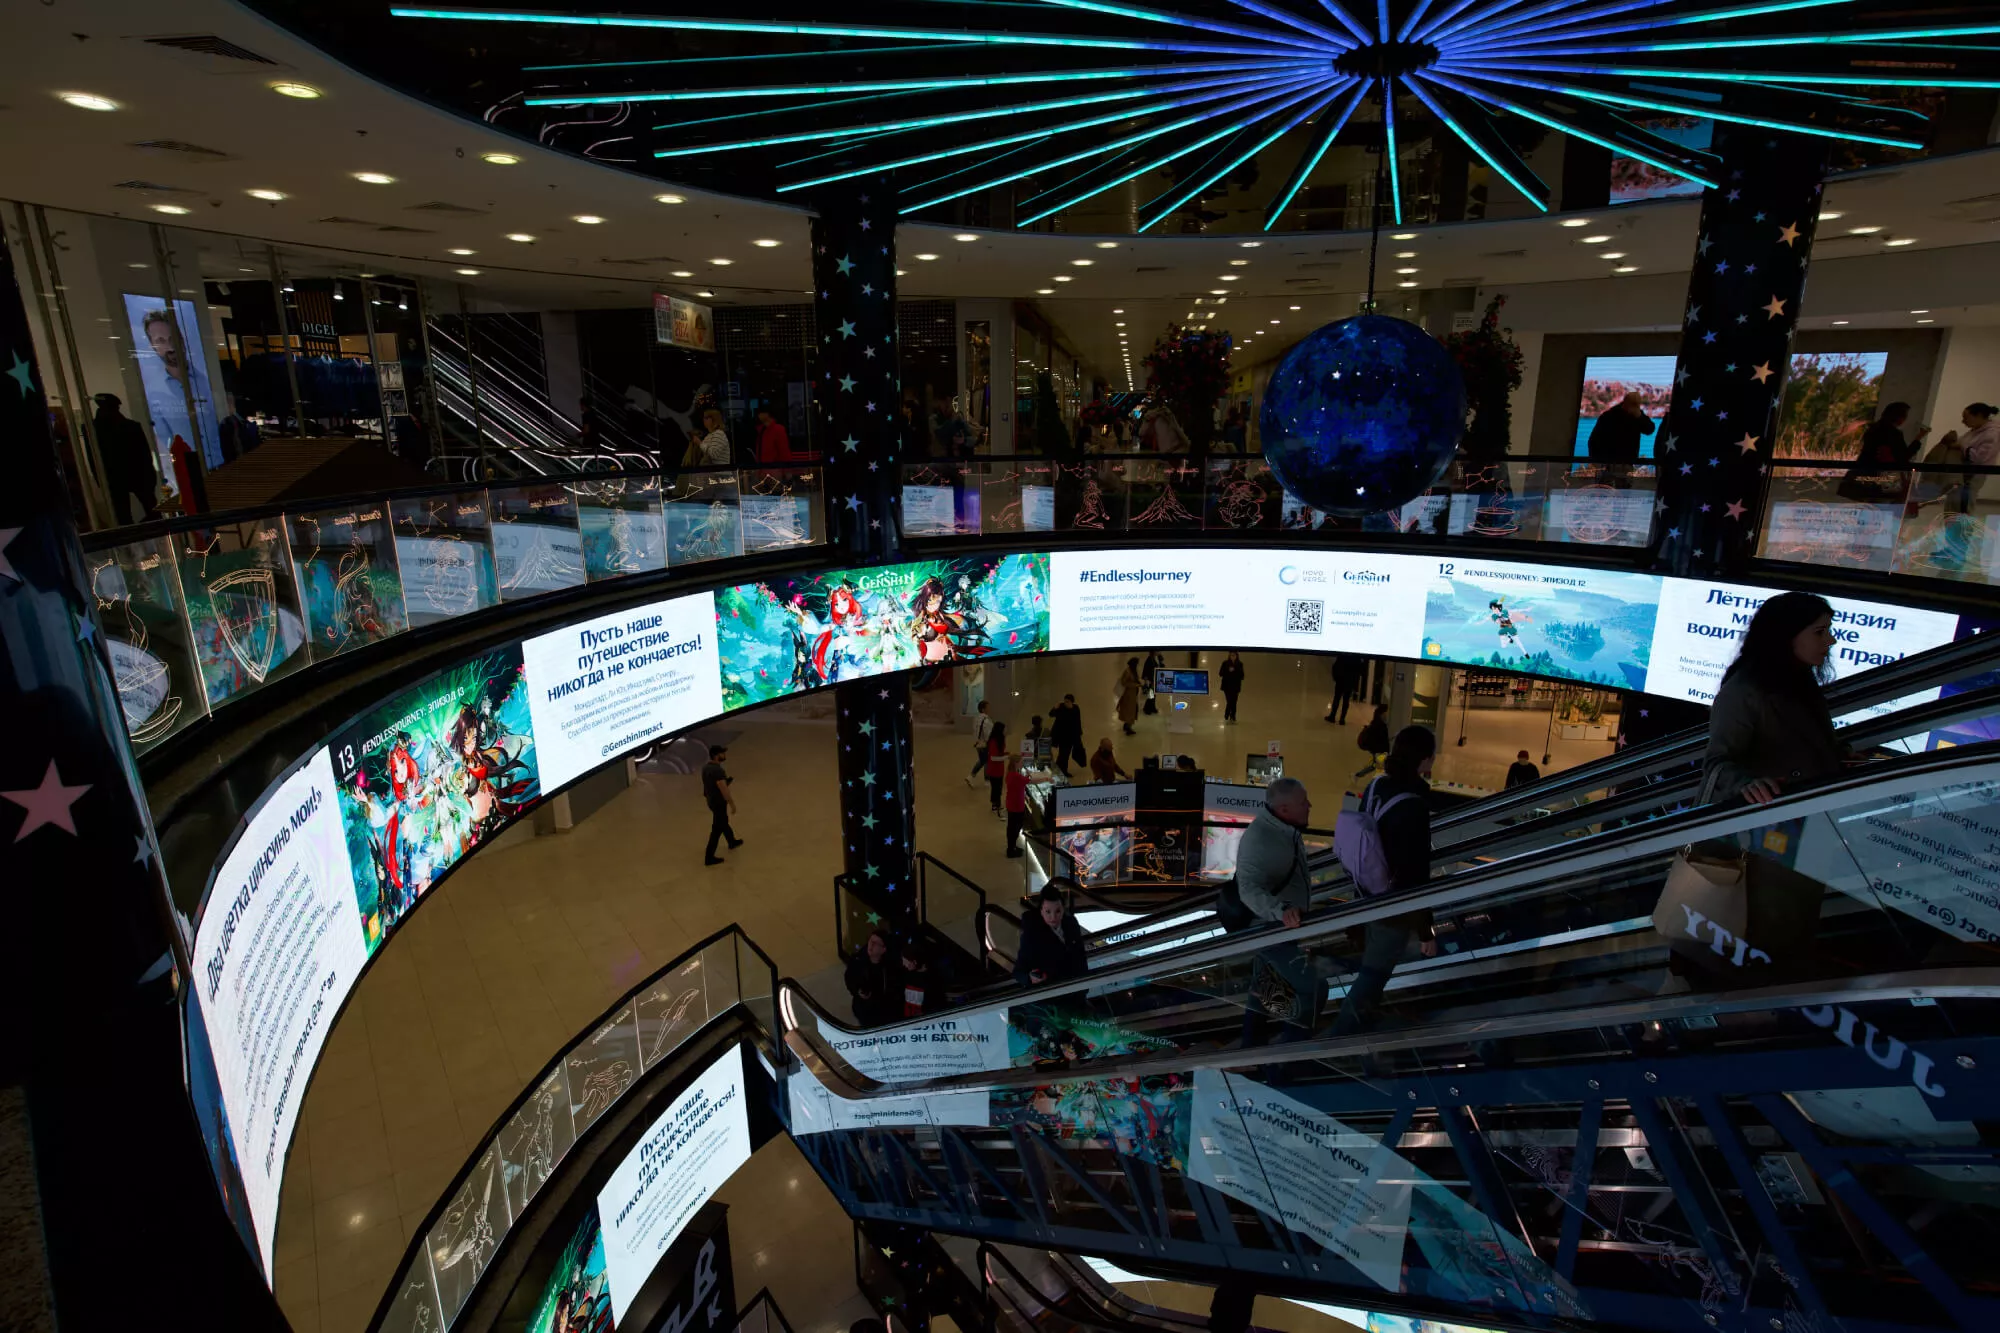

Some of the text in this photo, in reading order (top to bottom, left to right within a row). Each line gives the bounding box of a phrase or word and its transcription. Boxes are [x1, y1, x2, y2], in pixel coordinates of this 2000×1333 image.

[302, 322, 338, 337] DIGEL
[860, 570, 914, 590] GENSHIN
[1080, 569, 1192, 584] #EndlessJourney
[1439, 563, 1454, 575] 12
[1464, 569, 1539, 582] #ENDLESSJOURNEY:
[1541, 576, 1576, 586] ЭПИЗОД
[1706, 590, 1896, 631] Лётна ензия
[580, 615, 662, 648] Пусть наше
[1687, 622, 1745, 640] водит
[578, 632, 668, 669] путешествие
[548, 635, 700, 700] никогда не кончается!
[1688, 688, 1715, 700] Игро
[362, 687, 464, 756] #ENDLESSJOURNEY: ЭПИЗОД 13
[602, 722, 662, 756] @GenshinImpact
[338, 744, 355, 775] 13
[1063, 795, 1129, 808] ПАРФЮМЕРИЯ
[1216, 797, 1268, 808] КОСМЕТИ
[207, 787, 321, 1000] «Два цветка цинсинь мои!»
[274, 1065, 294, 1124] Genshin
[292, 1018, 312, 1067] Impact
[638, 1098, 708, 1180] путешествие
[640, 1088, 703, 1161] Пусть наше
[616, 1085, 734, 1227] никогда не кончается!
[657, 1186, 706, 1249] @GenshinImpact
